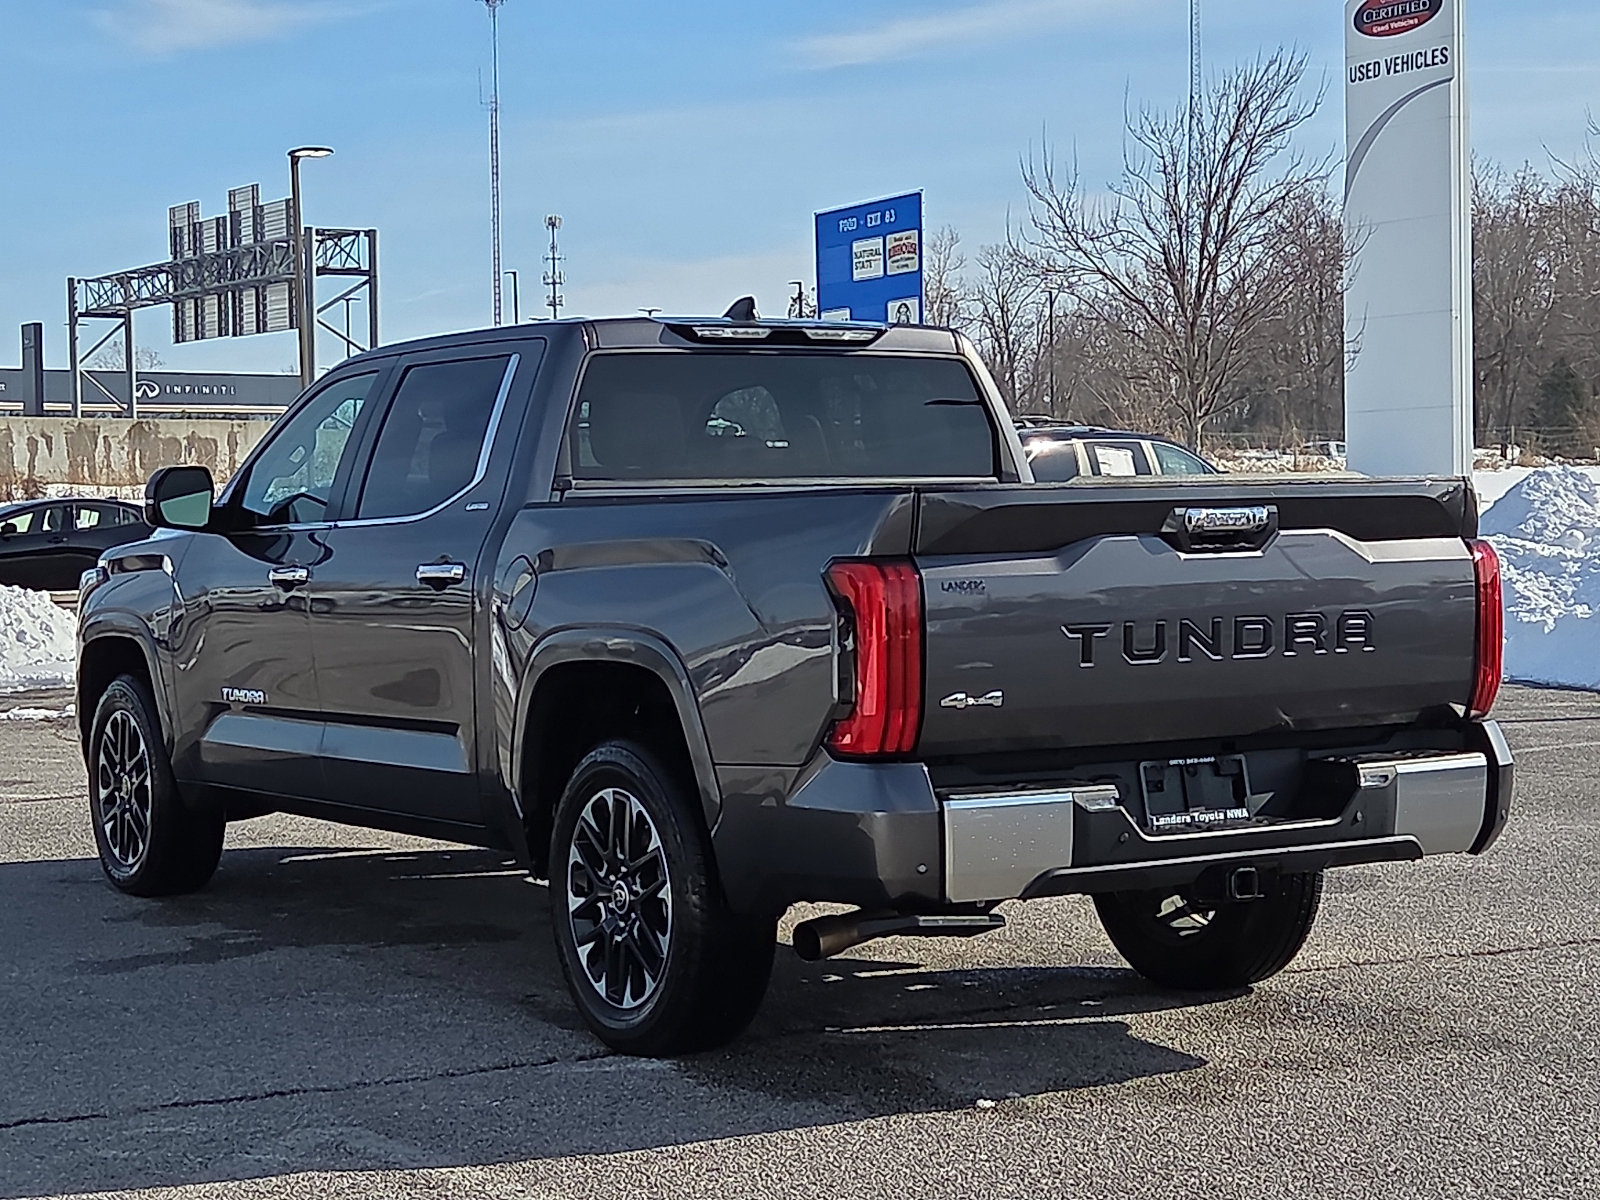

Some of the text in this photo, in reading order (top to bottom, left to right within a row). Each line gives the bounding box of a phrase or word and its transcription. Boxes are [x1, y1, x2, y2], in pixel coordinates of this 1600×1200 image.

[1363, 0, 1430, 23] CERTIFIED
[1349, 46, 1449, 83] USED VEHICLES
[165, 384, 236, 395] INFINITI
[1060, 609, 1378, 669] TUNDRA
[221, 687, 265, 705] TUNDRA
[940, 690, 1004, 709] 4x4
[1152, 808, 1249, 826] Landers Toyota NWA
